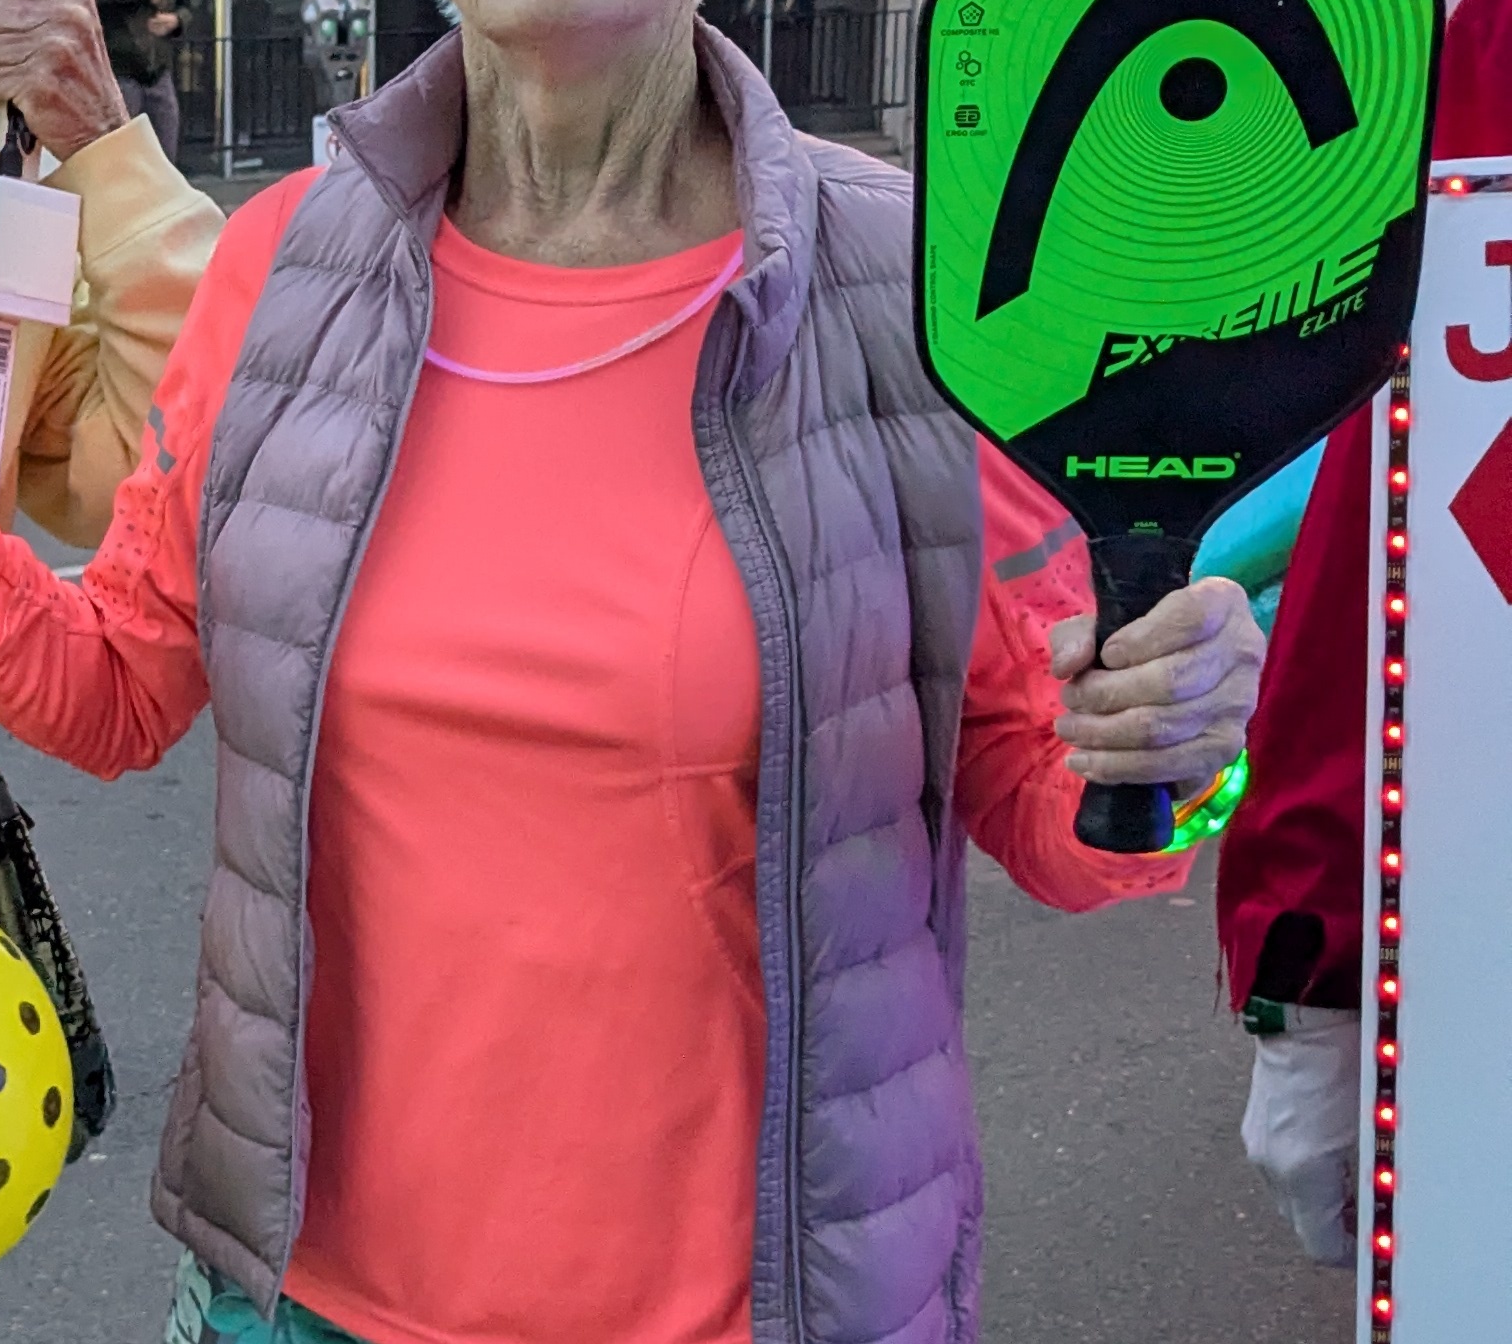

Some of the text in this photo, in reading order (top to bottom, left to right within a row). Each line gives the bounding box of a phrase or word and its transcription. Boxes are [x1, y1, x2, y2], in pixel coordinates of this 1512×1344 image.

[1102, 235, 1381, 379] EXTREME
[1299, 286, 1368, 339] ELITE
[1066, 456, 1236, 479] HEAD
